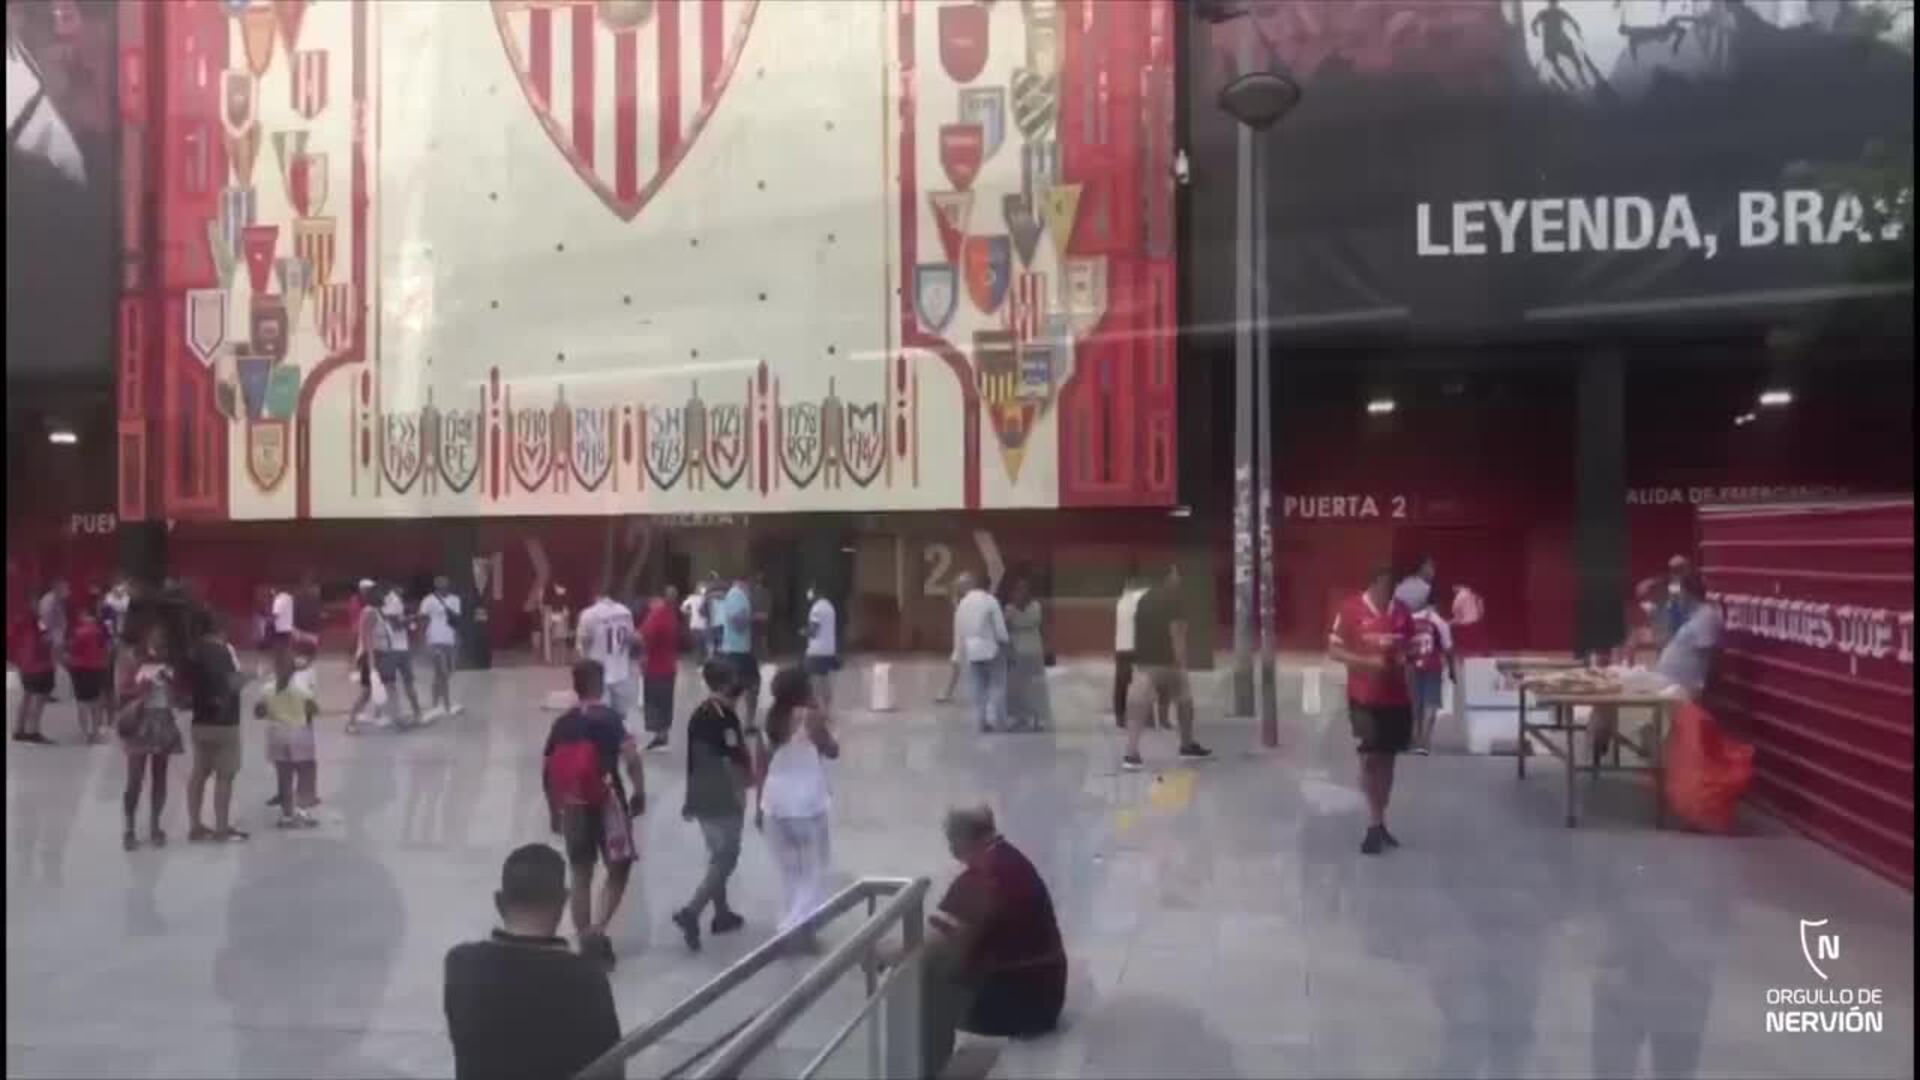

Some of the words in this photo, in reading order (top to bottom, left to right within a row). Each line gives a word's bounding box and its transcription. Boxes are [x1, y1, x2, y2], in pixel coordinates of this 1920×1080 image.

[1416, 193, 1718, 260] LEYENDA,
[847, 401, 878, 435] M
[1283, 495, 1380, 518] PUERTA
[1391, 495, 1407, 518] 2
[923, 543, 951, 596] 2
